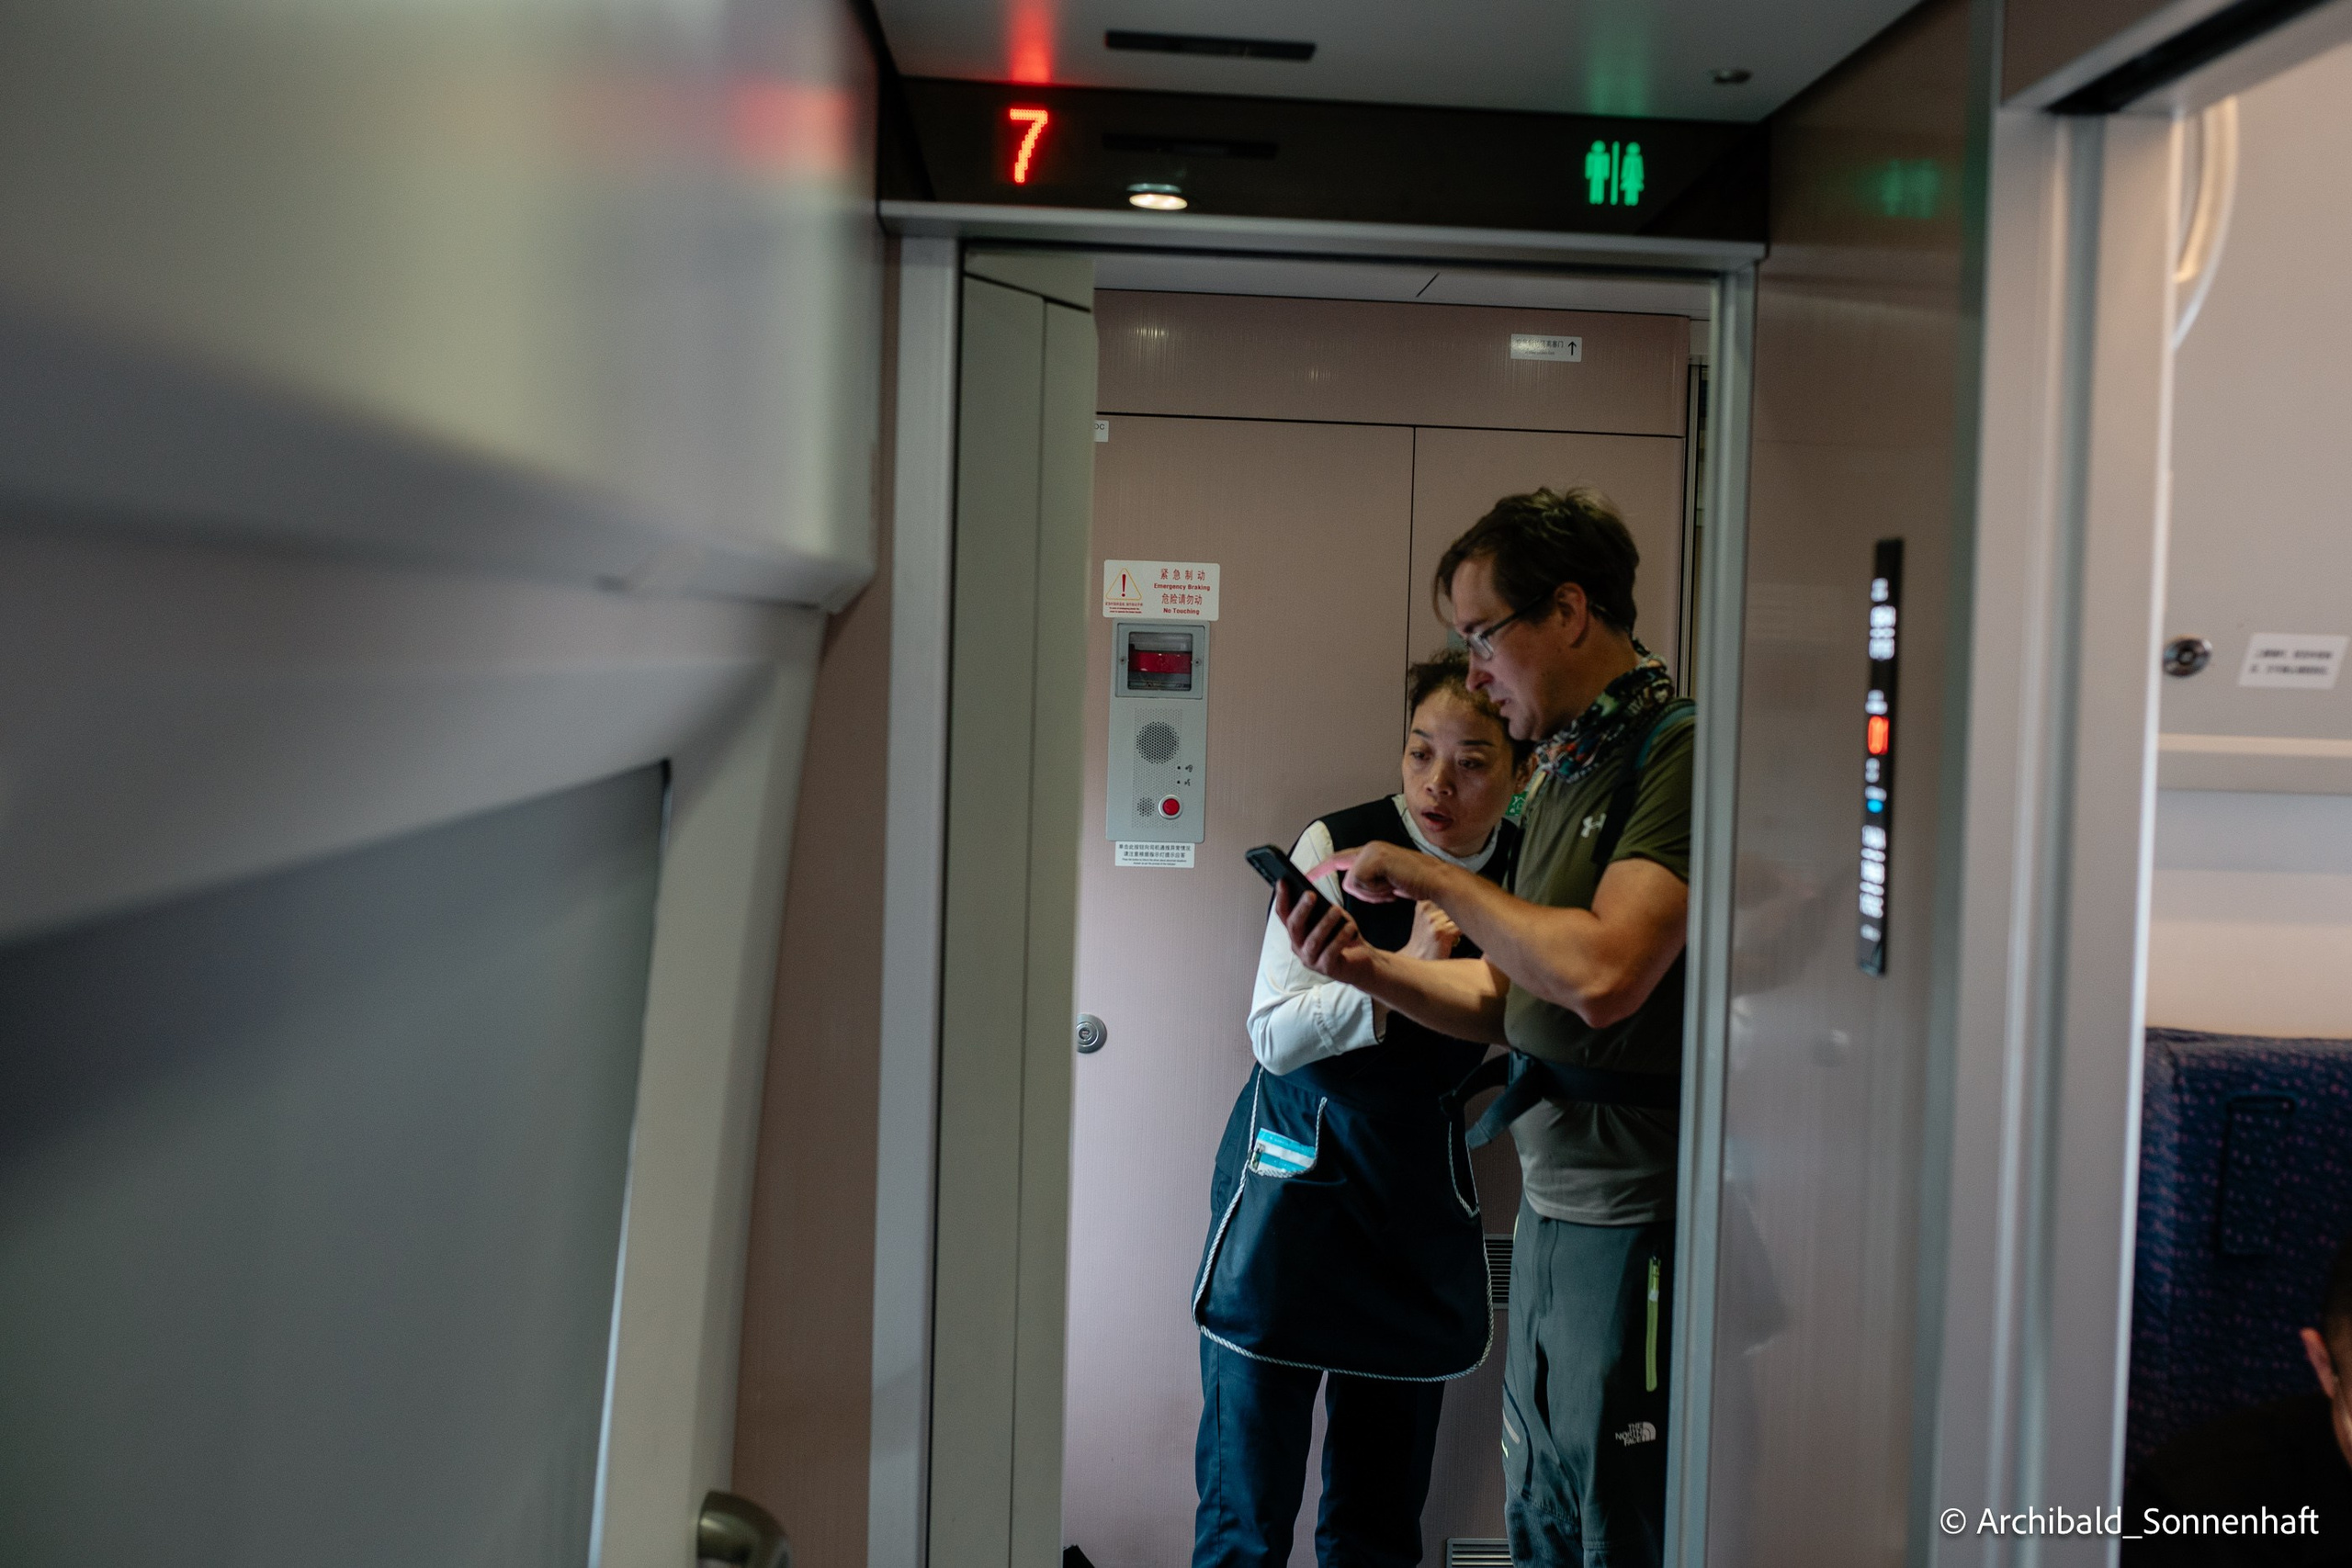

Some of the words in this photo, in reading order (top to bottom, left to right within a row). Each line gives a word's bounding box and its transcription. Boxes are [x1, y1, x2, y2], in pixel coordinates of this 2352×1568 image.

[1010, 108, 1048, 183] 7
[1160, 568, 1205, 581] 紧急制动
[1153, 582, 1186, 591] Emergency
[1187, 583, 1211, 592] Braking
[1161, 592, 1203, 605] 危险请勿动
[1172, 607, 1200, 615] Touching
